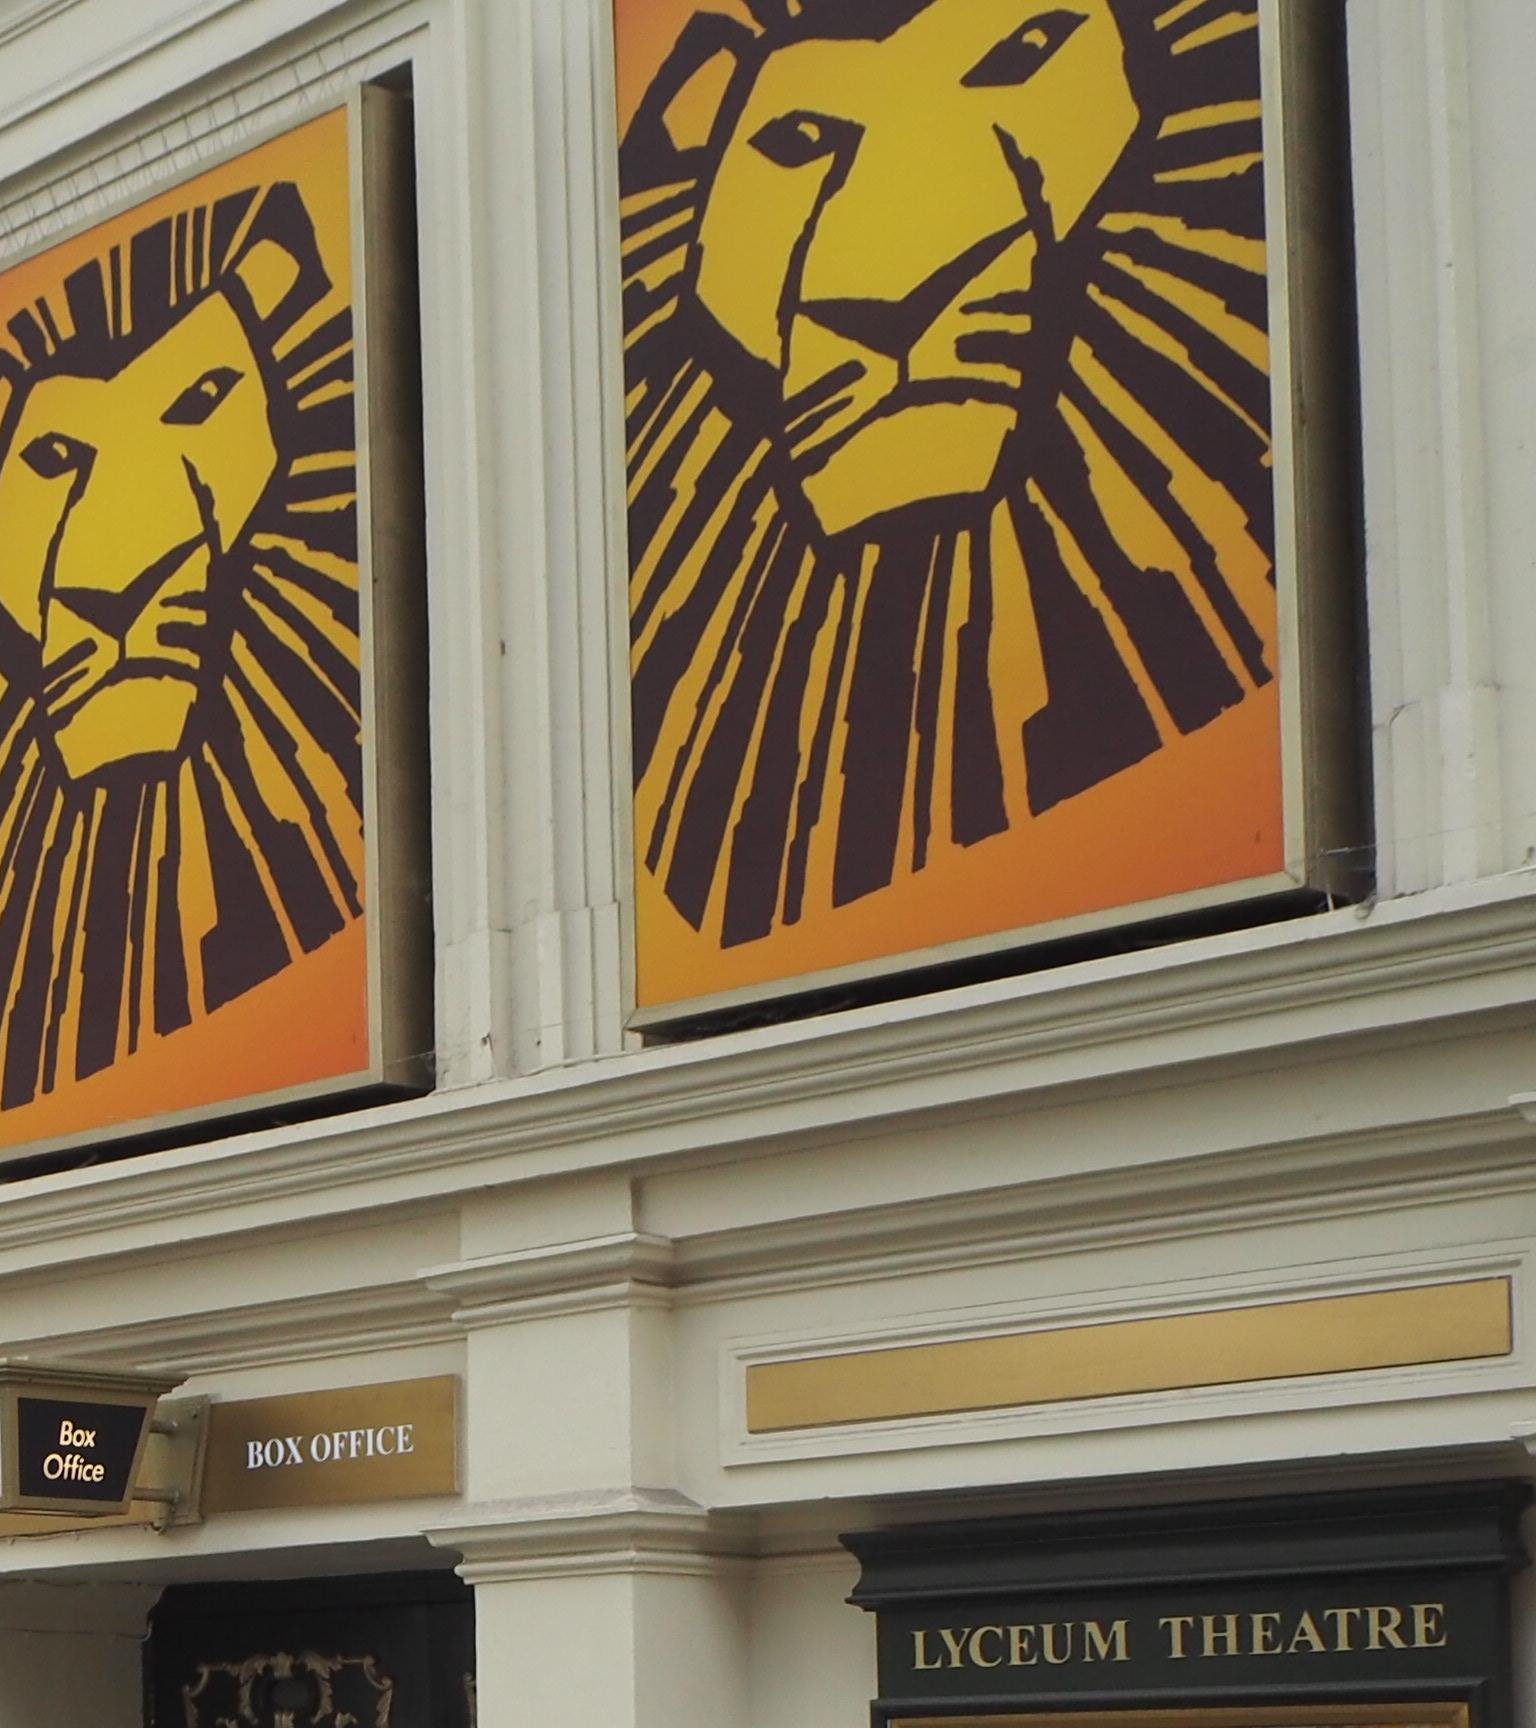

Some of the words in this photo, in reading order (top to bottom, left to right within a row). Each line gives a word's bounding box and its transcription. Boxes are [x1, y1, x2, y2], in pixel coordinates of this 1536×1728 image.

[58, 1419, 97, 1449] Box
[246, 1435, 302, 1470] BOX
[310, 1423, 415, 1462] OFFICE
[42, 1454, 105, 1484] Office
[911, 1619, 1130, 1671] LYCEUM
[1158, 1603, 1448, 1661] THEATRE
